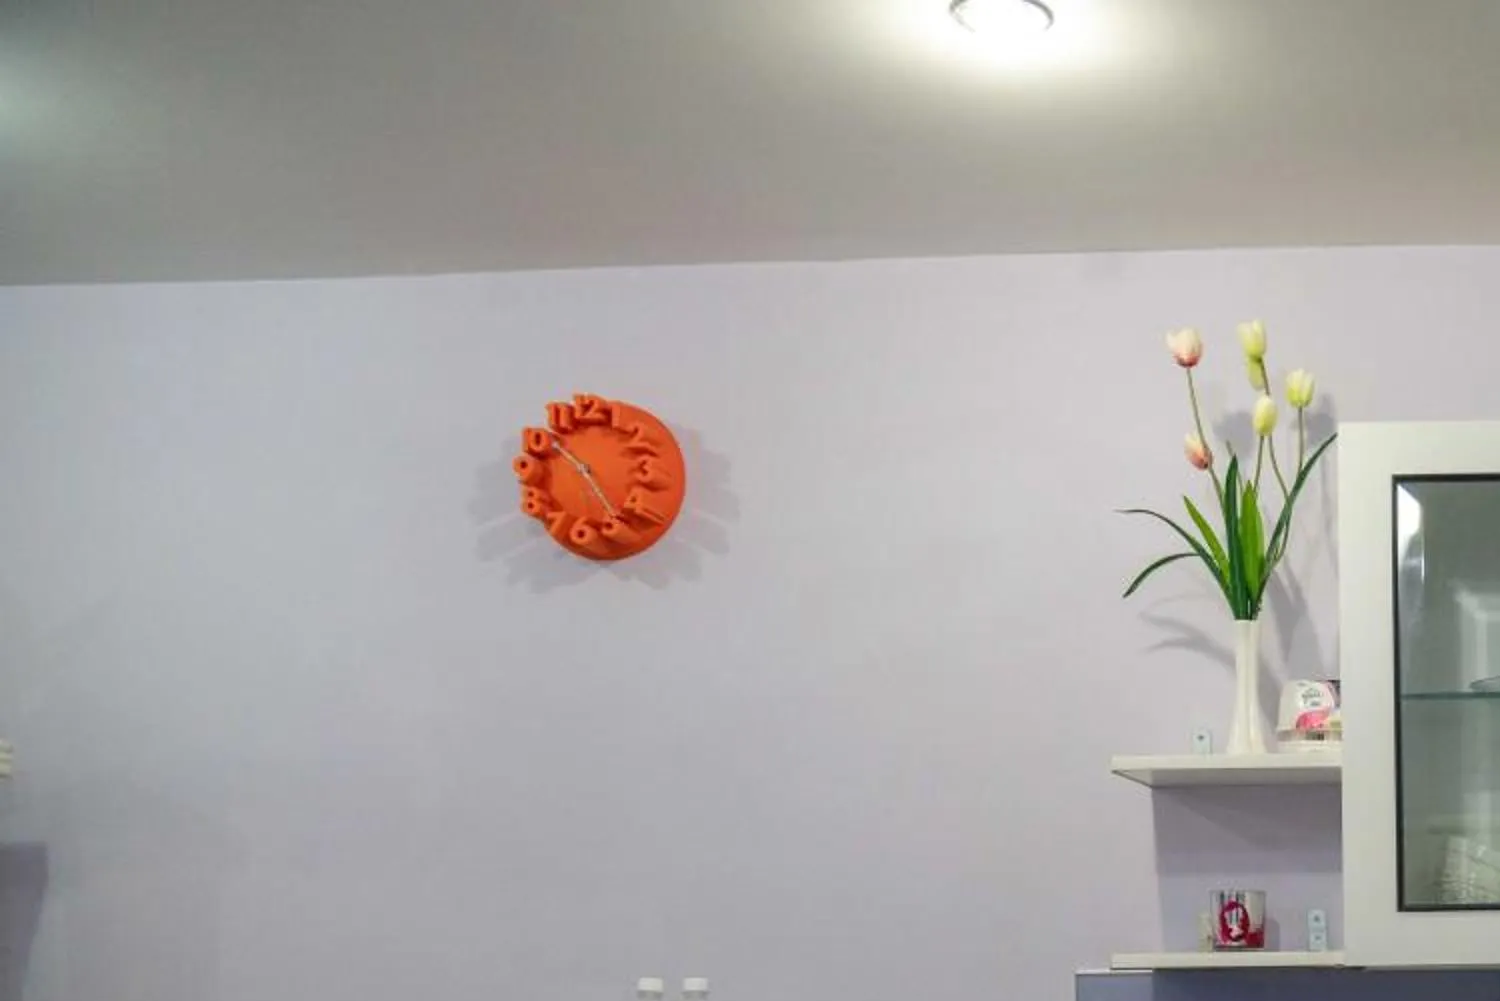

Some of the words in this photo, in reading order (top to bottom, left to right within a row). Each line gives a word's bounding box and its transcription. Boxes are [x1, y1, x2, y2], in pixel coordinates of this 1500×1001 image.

[548, 402, 568, 429] 11
[574, 394, 608, 420] 12
[512, 456, 534, 482] 9
[635, 456, 653, 483] 3
[522, 486, 541, 514] 8
[547, 511, 567, 536] 7
[569, 518, 592, 545] 6
